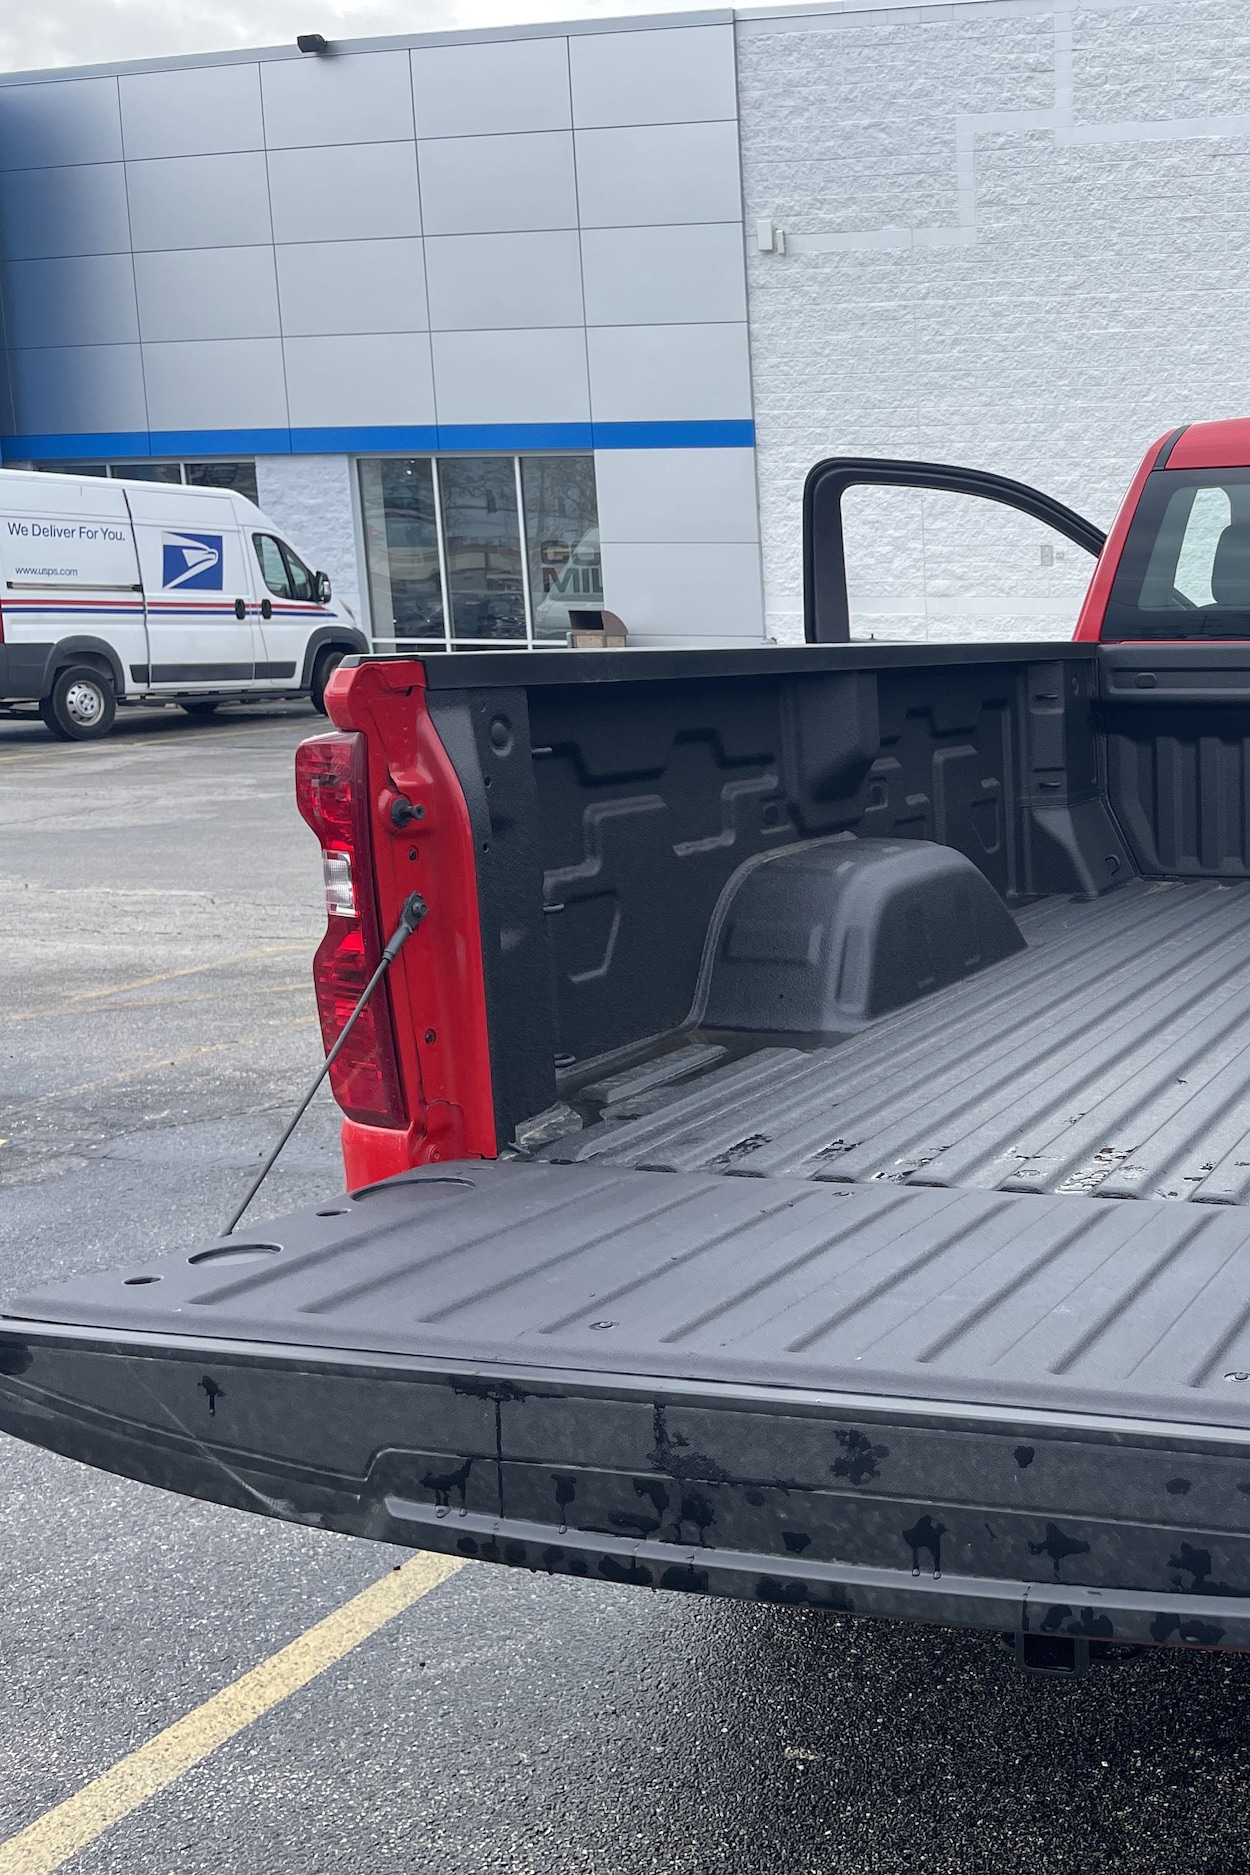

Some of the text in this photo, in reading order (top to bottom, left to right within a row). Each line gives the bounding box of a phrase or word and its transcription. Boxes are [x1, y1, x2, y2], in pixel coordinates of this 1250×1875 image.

[7, 522, 126, 541] We Deliver For You.
[15, 567, 78, 577] www.usps.com
